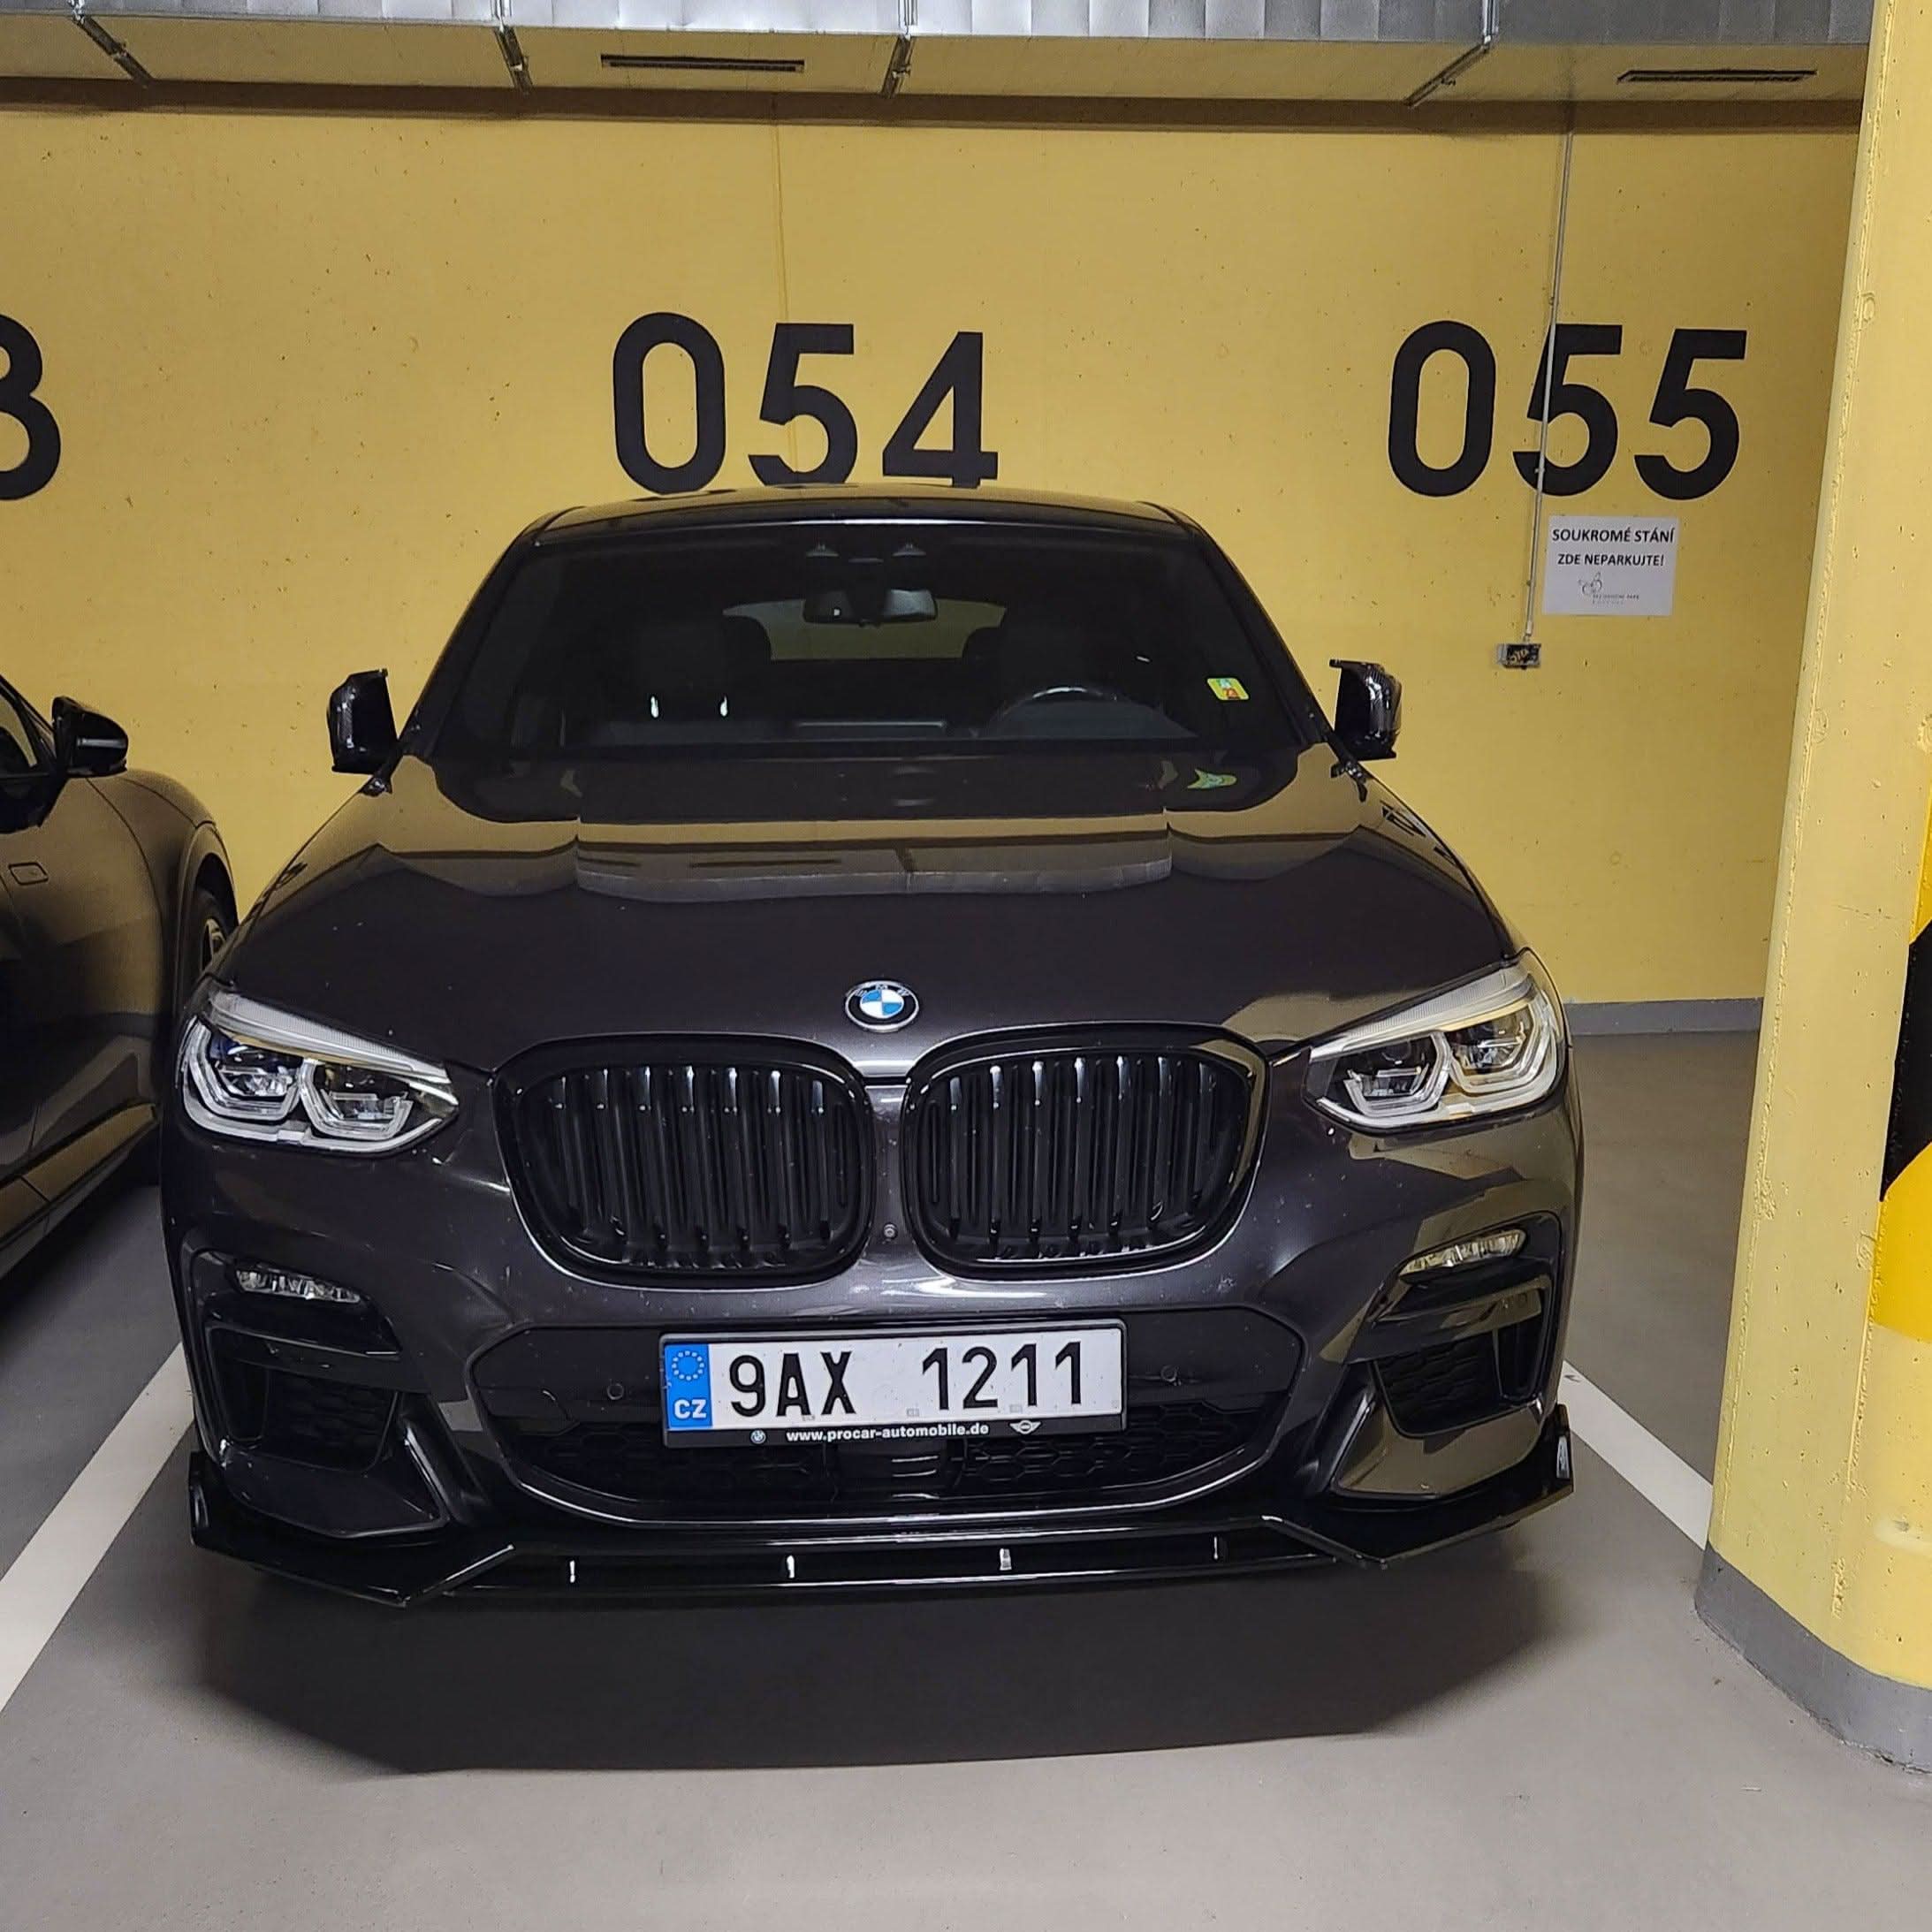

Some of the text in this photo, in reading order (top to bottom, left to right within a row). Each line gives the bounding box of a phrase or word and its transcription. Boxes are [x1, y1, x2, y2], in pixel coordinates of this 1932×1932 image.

[612, 312, 999, 495] 054
[1388, 320, 1747, 500] 055
[1552, 527, 1675, 543] SOUKROMÉ STÁNÍ
[1557, 553, 1664, 567] ZDE NEPARKUJTE!
[729, 1341, 1082, 1418] 9AX 1211
[674, 1399, 707, 1419] CZ
[787, 1423, 989, 1442] www.procar-automobile.de
